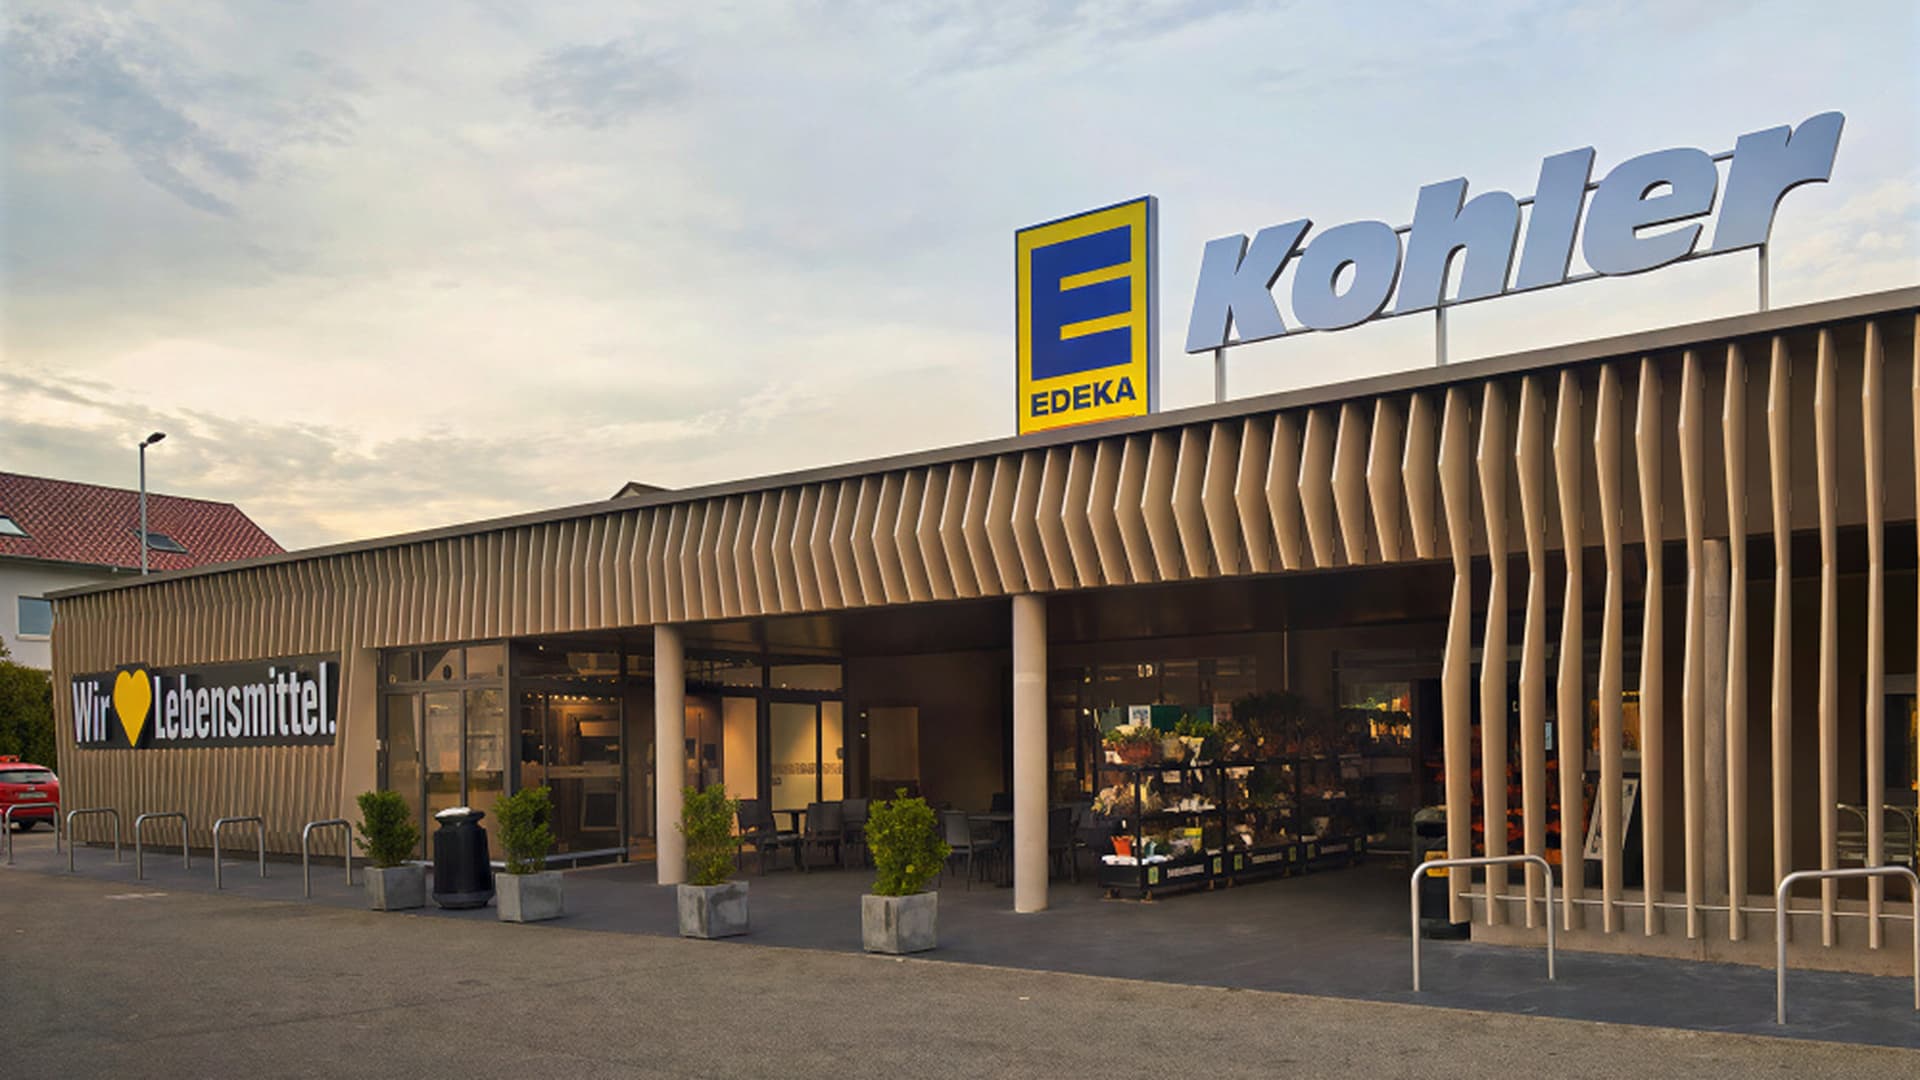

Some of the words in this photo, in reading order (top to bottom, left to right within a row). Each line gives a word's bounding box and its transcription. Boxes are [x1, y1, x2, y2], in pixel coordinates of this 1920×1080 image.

[1186, 112, 1845, 353] Kohler
[1031, 224, 1131, 381] E
[1031, 376, 1136, 417] EDEKA
[72, 681, 110, 743] Wir
[153, 661, 337, 740] Lebensmittel.
